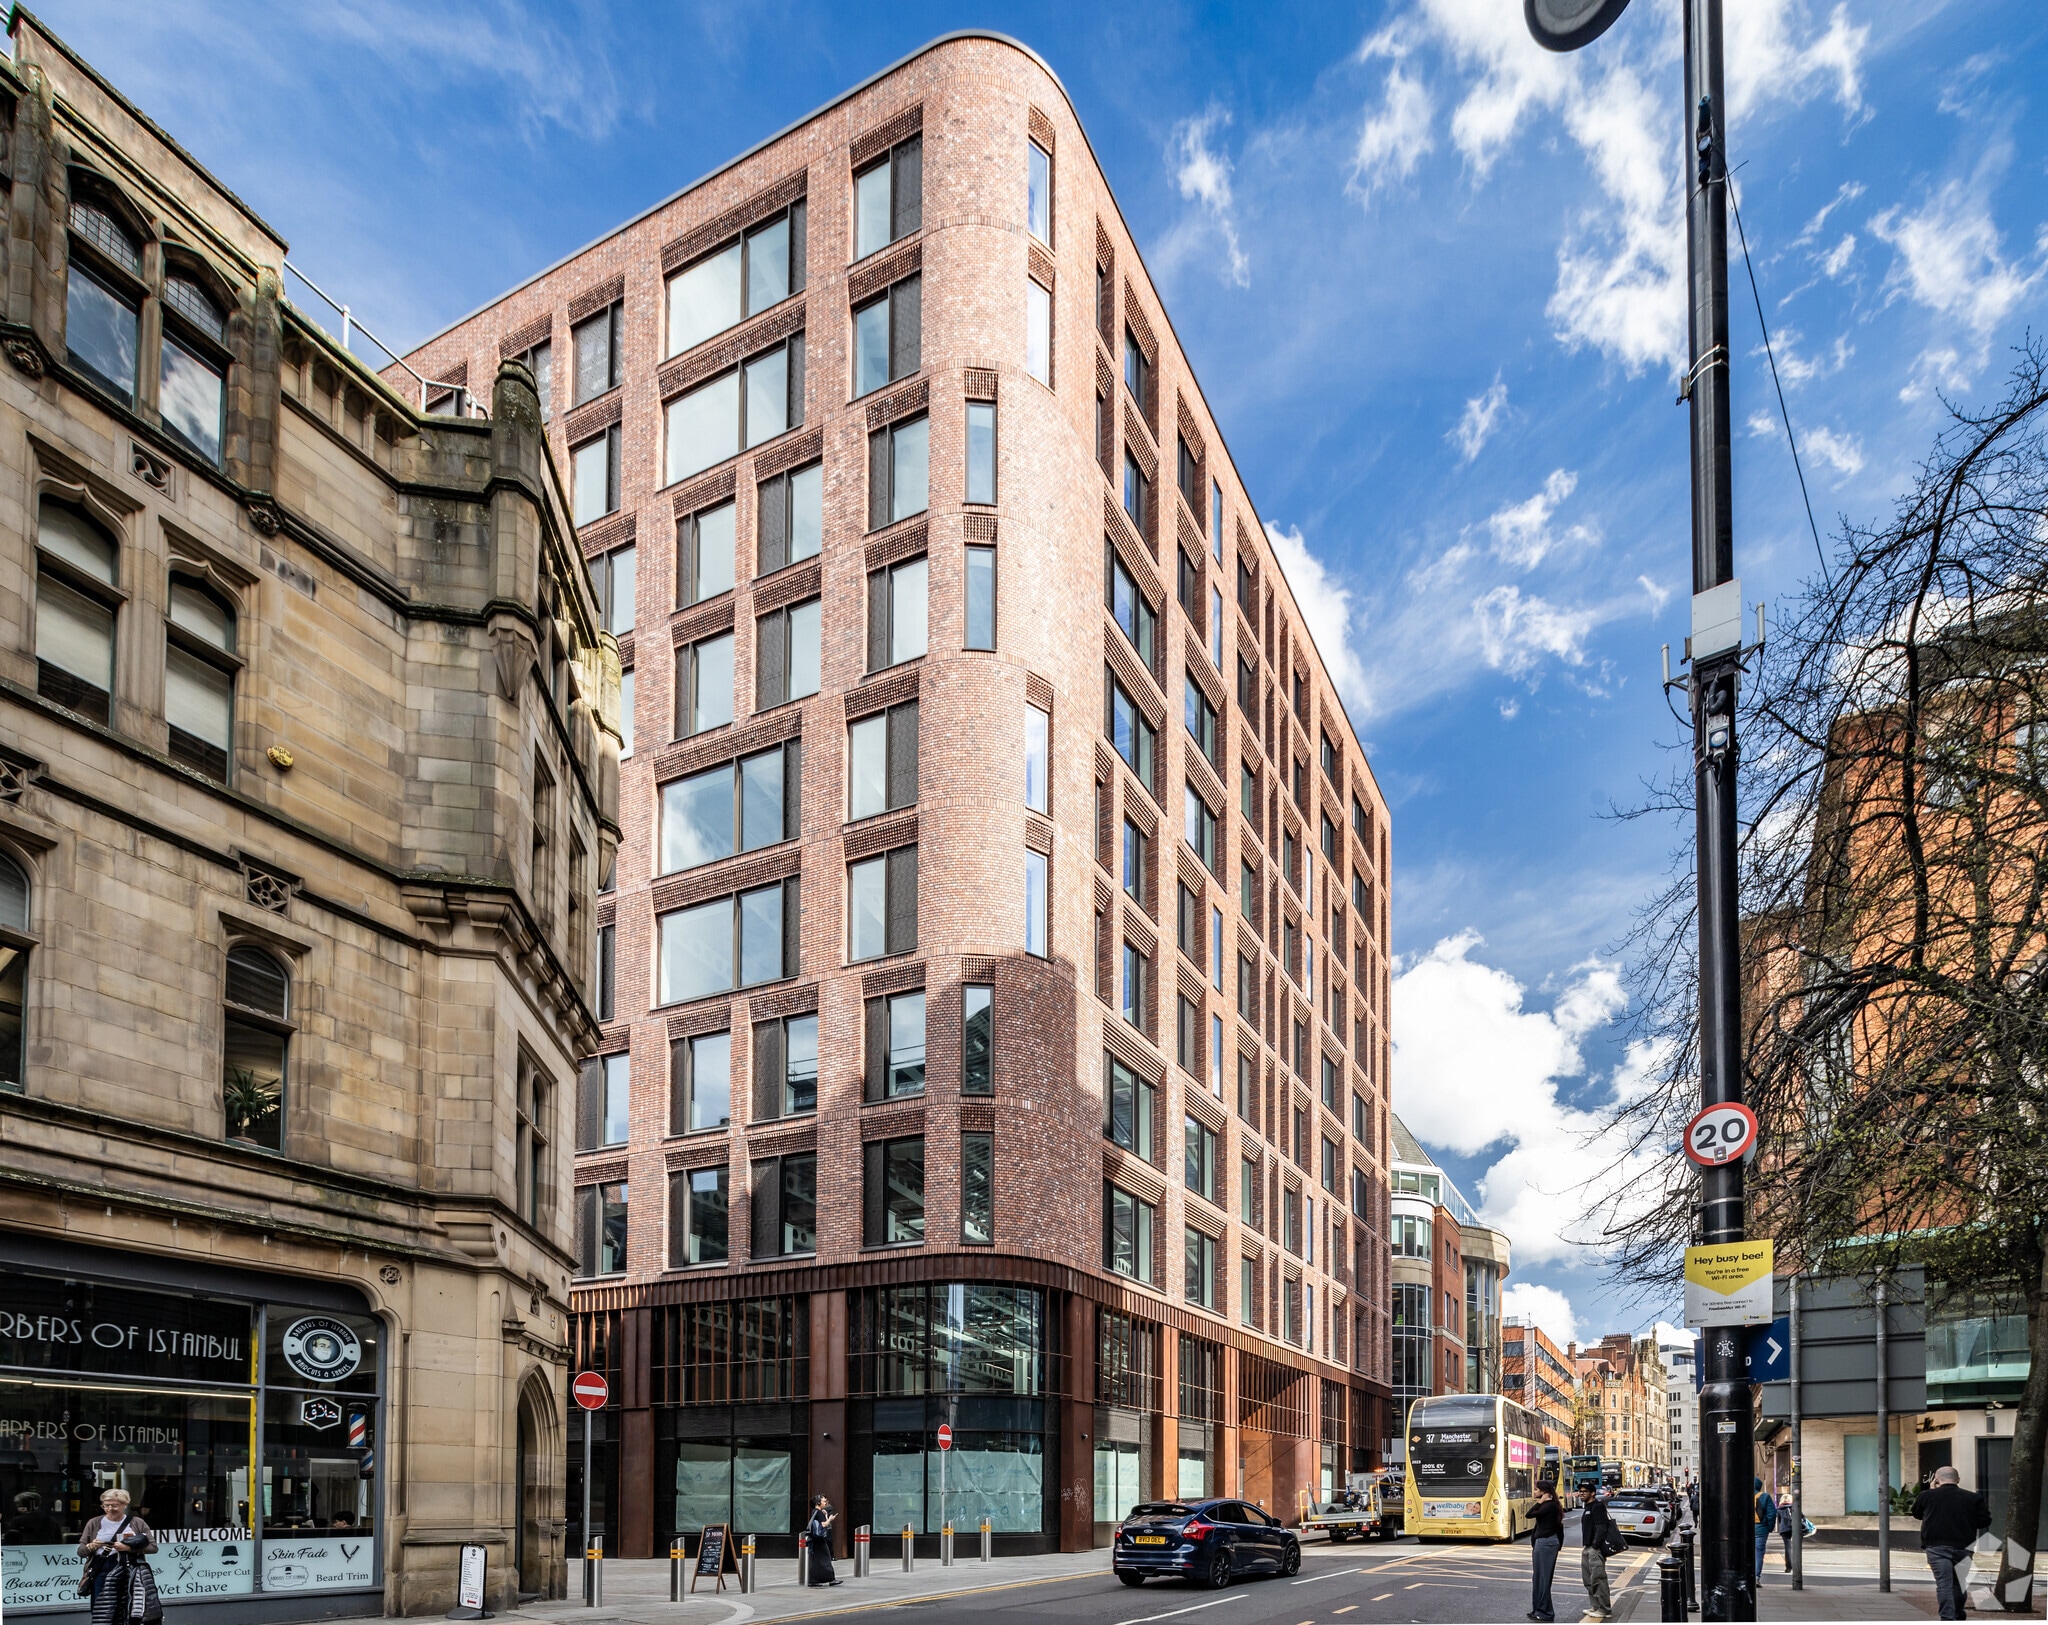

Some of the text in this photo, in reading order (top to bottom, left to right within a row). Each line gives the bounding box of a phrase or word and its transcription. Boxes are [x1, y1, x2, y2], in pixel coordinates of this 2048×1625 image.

[1695, 1118, 1746, 1150] 20
[1694, 1251, 1764, 1266] Hey busy bee!
[292, 1321, 316, 1337] BARBERS
[330, 1323, 352, 1343] ISTANBUL
[91, 1323, 139, 1350] OF
[148, 1328, 244, 1361] ISTANBUL
[295, 1359, 321, 1378] HAIRCUTS
[331, 1364, 352, 1377] SHAVES
[73, 1423, 107, 1441] OF
[1426, 1433, 1435, 1443] 37
[1436, 1502, 1465, 1510] wellbaby
[174, 1527, 252, 1543] WELCOME
[168, 1545, 204, 1561] Style
[267, 1547, 328, 1561] Skin Fade
[196, 1568, 251, 1579] Clipper Cut
[316, 1573, 344, 1582] Beard
[346, 1572, 369, 1581] Trim
[5, 1575, 80, 1590] Beard Trim
[156, 1582, 228, 1595] Wet Shave
